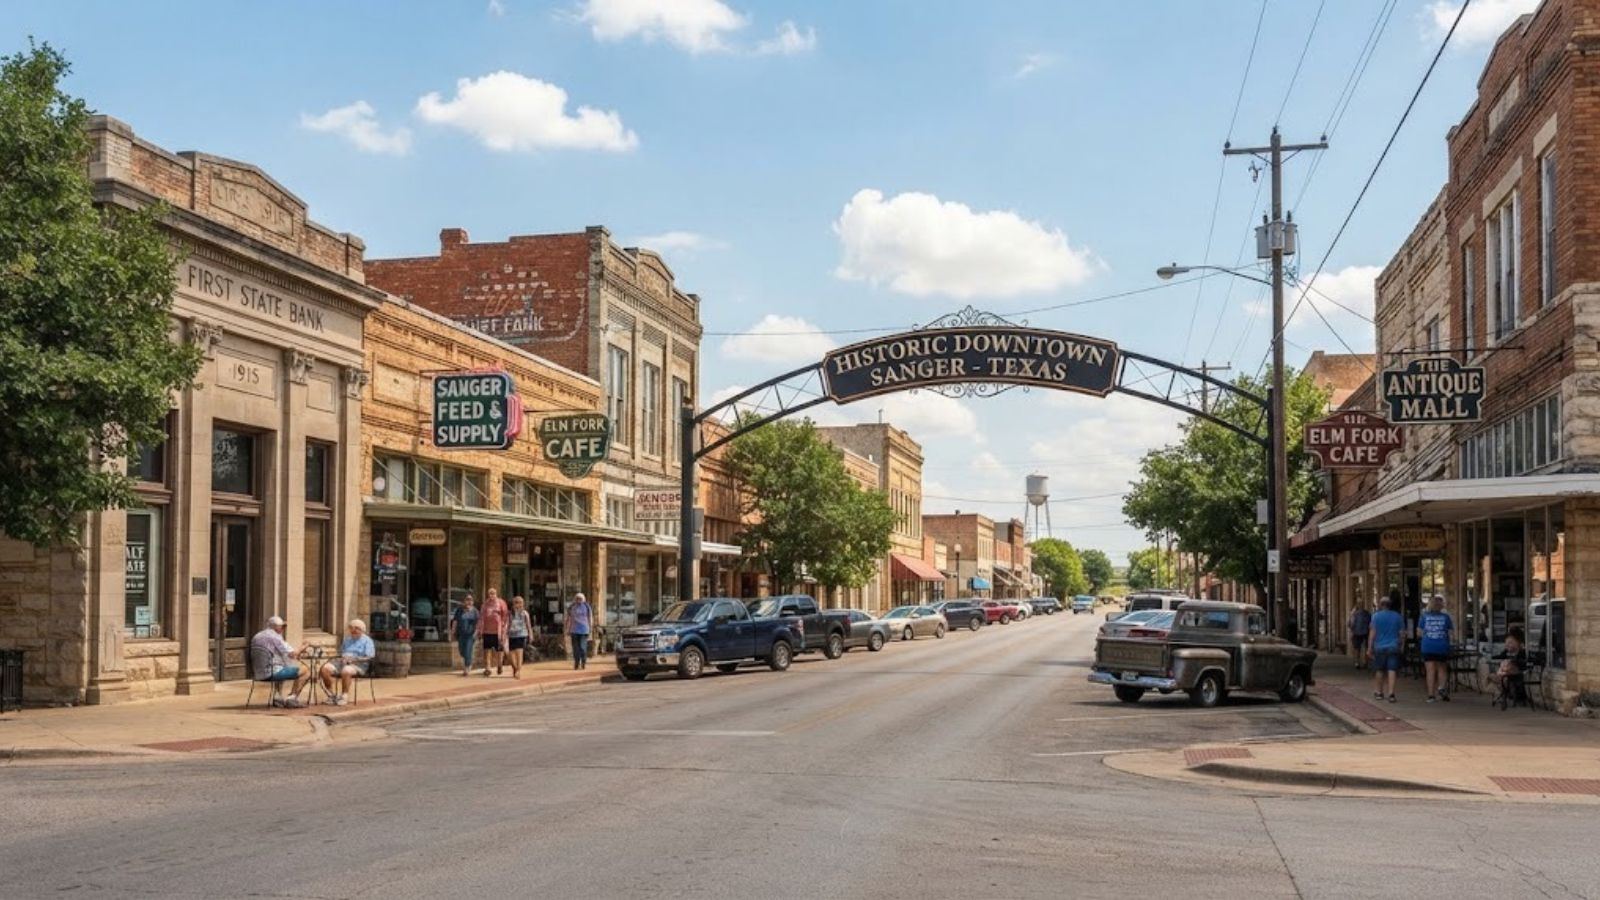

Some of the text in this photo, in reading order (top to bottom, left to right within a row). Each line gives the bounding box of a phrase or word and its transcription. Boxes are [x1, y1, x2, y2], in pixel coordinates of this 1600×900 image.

[188, 264, 325, 333] FIRST STATE BANK
[834, 333, 1107, 375] HISTORIC DOWNTOWN
[232, 363, 260, 384] 1915
[871, 358, 965, 387] SANGER
[987, 357, 1067, 382] TEXAS
[436, 378, 502, 398] SANGER
[1387, 372, 1481, 398] ANTIQUE
[437, 400, 503, 421] FEED &
[1401, 398, 1469, 419] MALL
[437, 423, 502, 444] SUPPLY
[572, 418, 607, 432] FORK
[1309, 427, 1400, 445] ELM FORK
[546, 437, 603, 459] CAFE
[1329, 446, 1379, 463] CAFE
